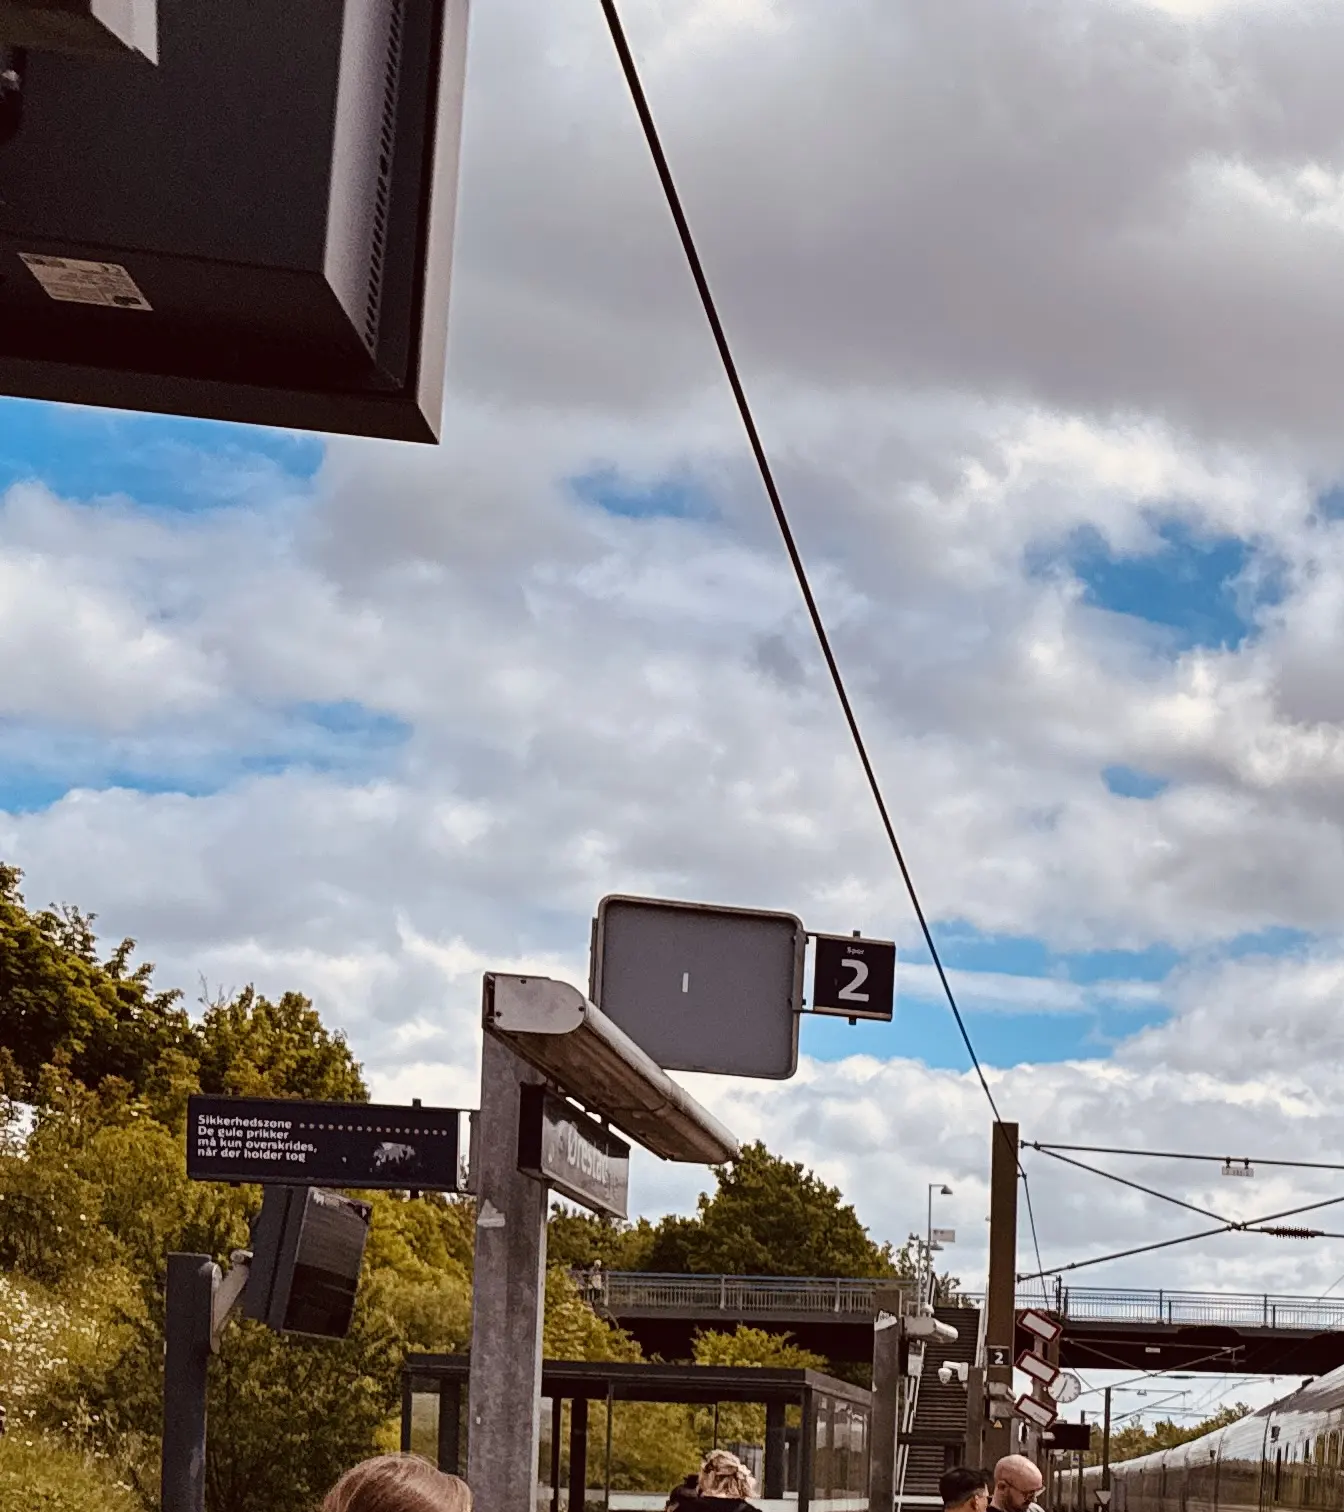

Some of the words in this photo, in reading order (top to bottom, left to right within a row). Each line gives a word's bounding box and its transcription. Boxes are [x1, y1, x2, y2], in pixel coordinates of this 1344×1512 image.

[838, 958, 869, 1002] 2
[198, 1114, 292, 1129] Sikkerhedszone
[198, 1126, 214, 1136] De
[218, 1127, 243, 1138] gule
[246, 1129, 289, 1140] prikker
[198, 1137, 217, 1147] må
[220, 1138, 242, 1148] kun
[246, 1140, 318, 1154] overskrides,
[198, 1147, 218, 1157] når
[221, 1148, 241, 1158] der
[244, 1149, 283, 1160] holder
[286, 1151, 306, 1163] tog
[994, 1351, 1004, 1364] 2
